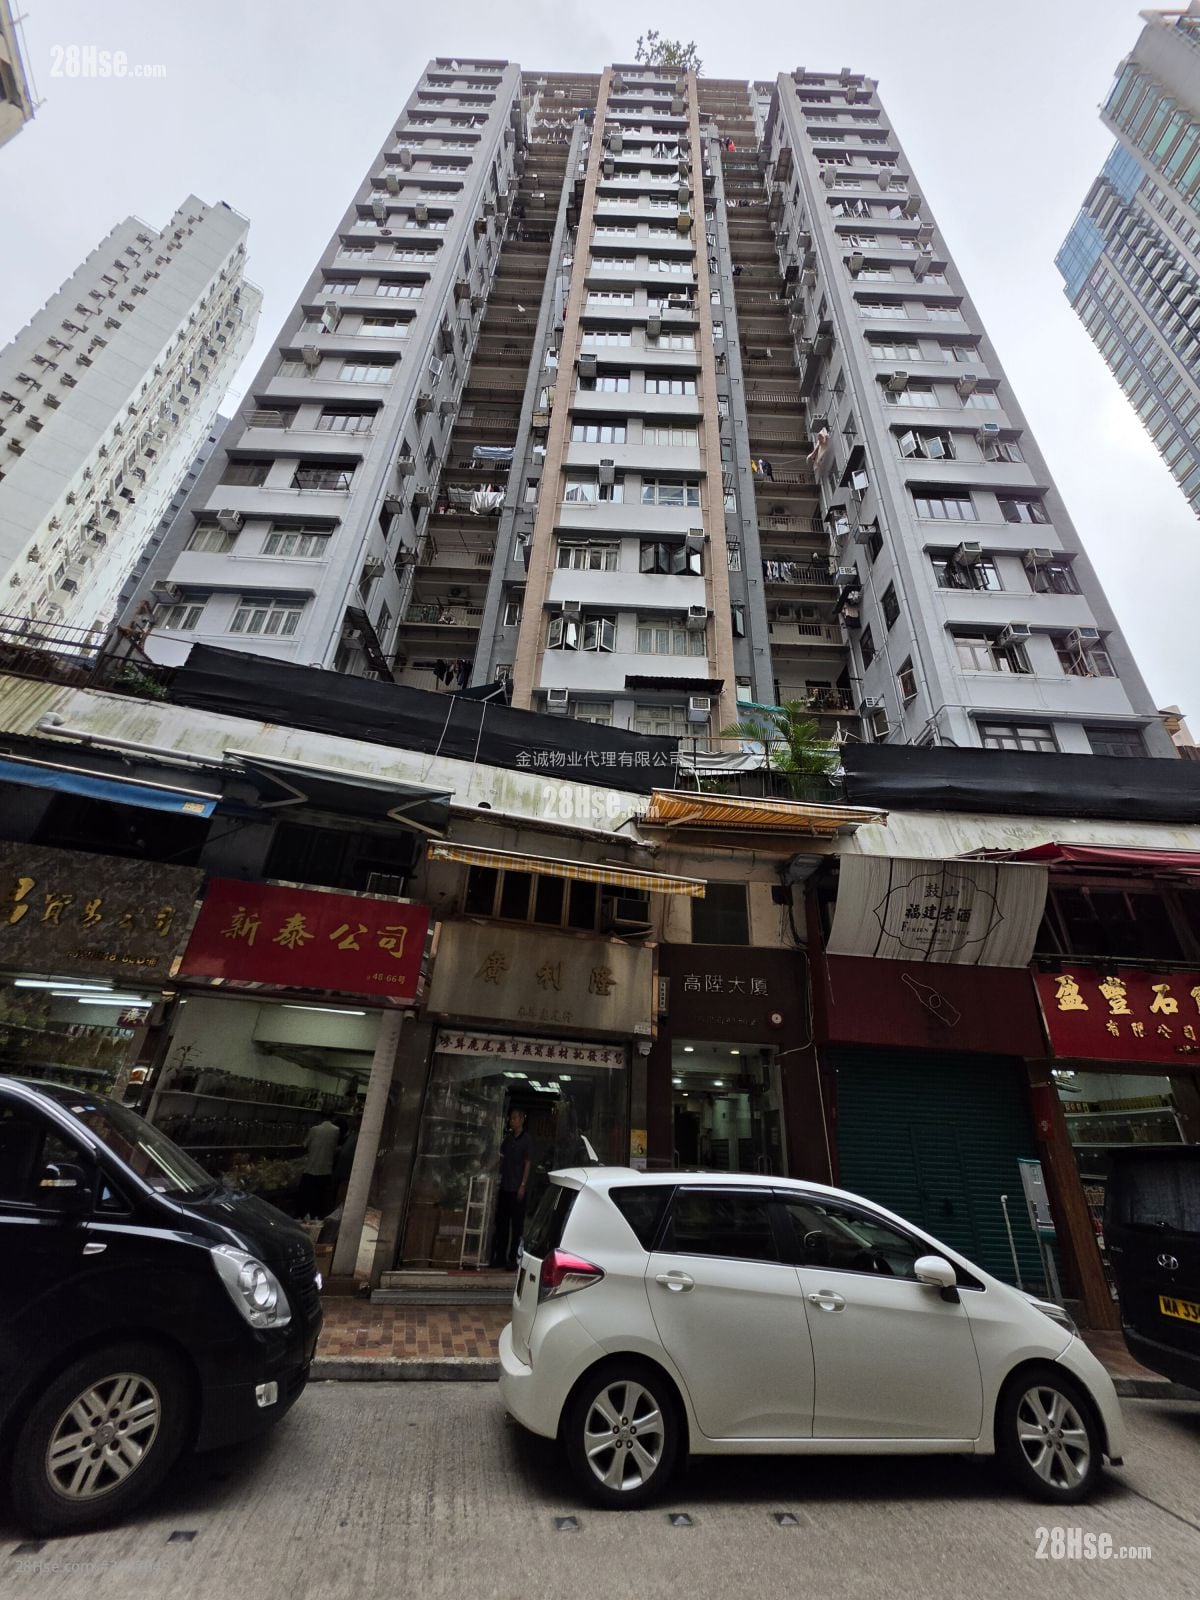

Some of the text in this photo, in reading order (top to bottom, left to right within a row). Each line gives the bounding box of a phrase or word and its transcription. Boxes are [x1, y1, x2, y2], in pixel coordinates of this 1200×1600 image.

[924, 882, 960, 899] 鼓山
[905, 904, 972, 923] 福建老酒
[220, 906, 409, 959] 新泰公司
[682, 973, 769, 997] 高陞大廈
[1105, 1019, 1197, 1042] 有限公司
[1182, 1302, 1200, 1320] 33
